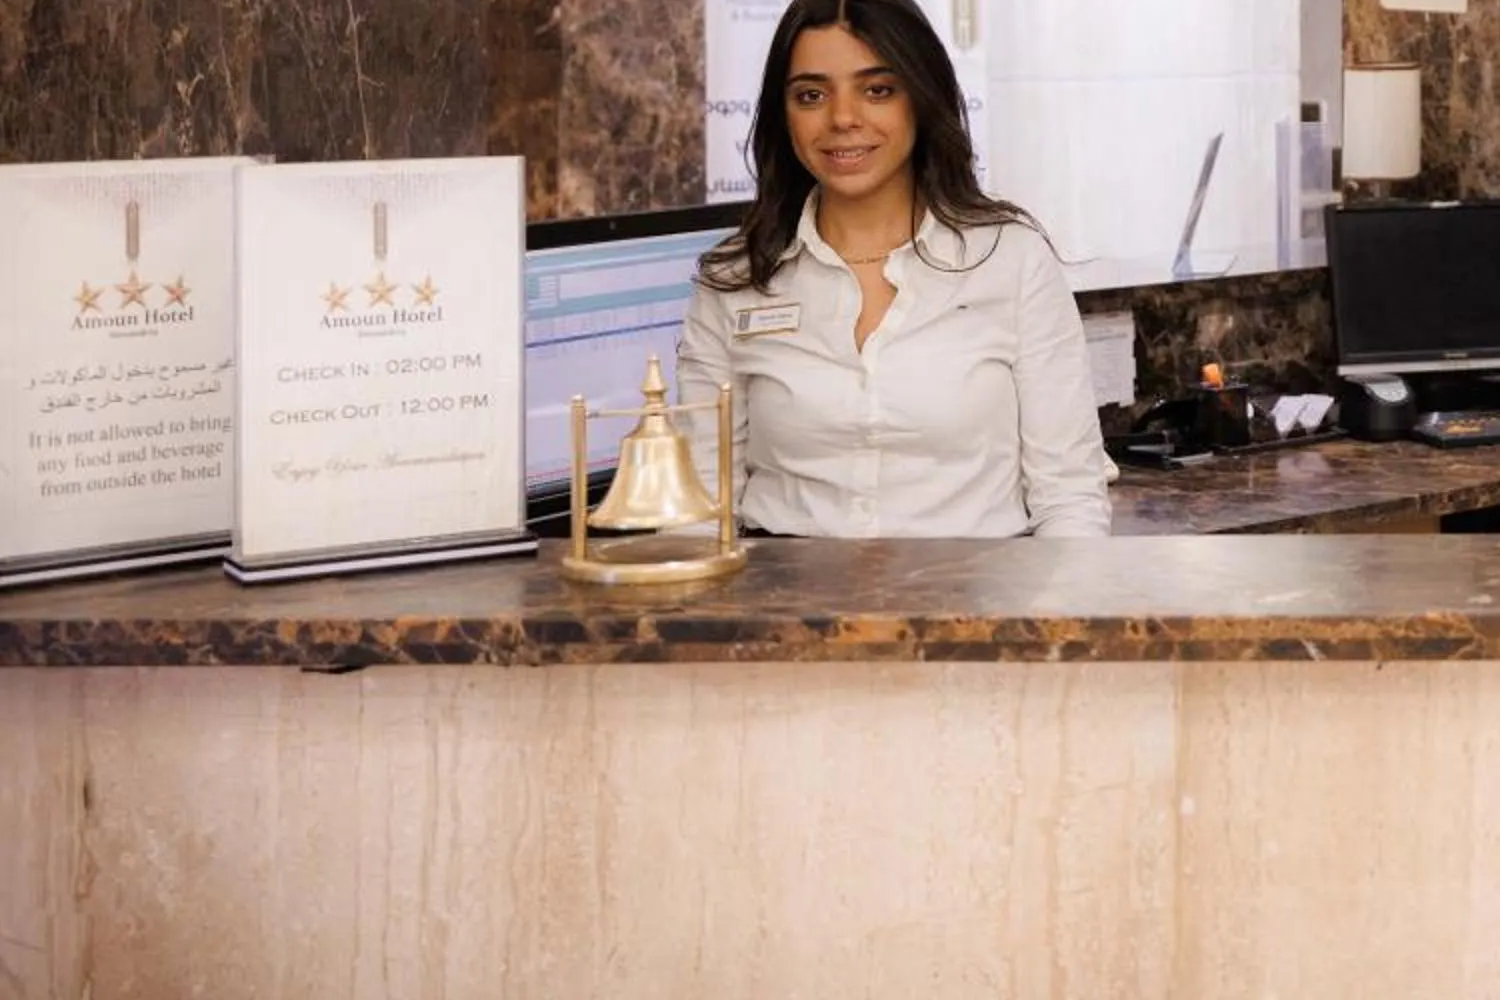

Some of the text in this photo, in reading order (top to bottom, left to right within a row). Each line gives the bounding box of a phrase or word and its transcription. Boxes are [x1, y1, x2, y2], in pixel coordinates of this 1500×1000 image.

[71, 306, 194, 331] Amoun Hotel
[320, 306, 443, 330] Amoun Hotel
[277, 366, 345, 383] CHECK
[351, 362, 370, 378] IN
[386, 355, 447, 376] 02:00
[453, 353, 482, 370] PM
[270, 410, 337, 426] CHECK
[341, 404, 382, 420] OUT
[402, 397, 455, 415] 12:00
[460, 394, 490, 410] PM
[29, 415, 233, 450] It is not allowed to bring
[37, 440, 225, 476] any food and beverage
[40, 461, 222, 497] from outside the hotel
